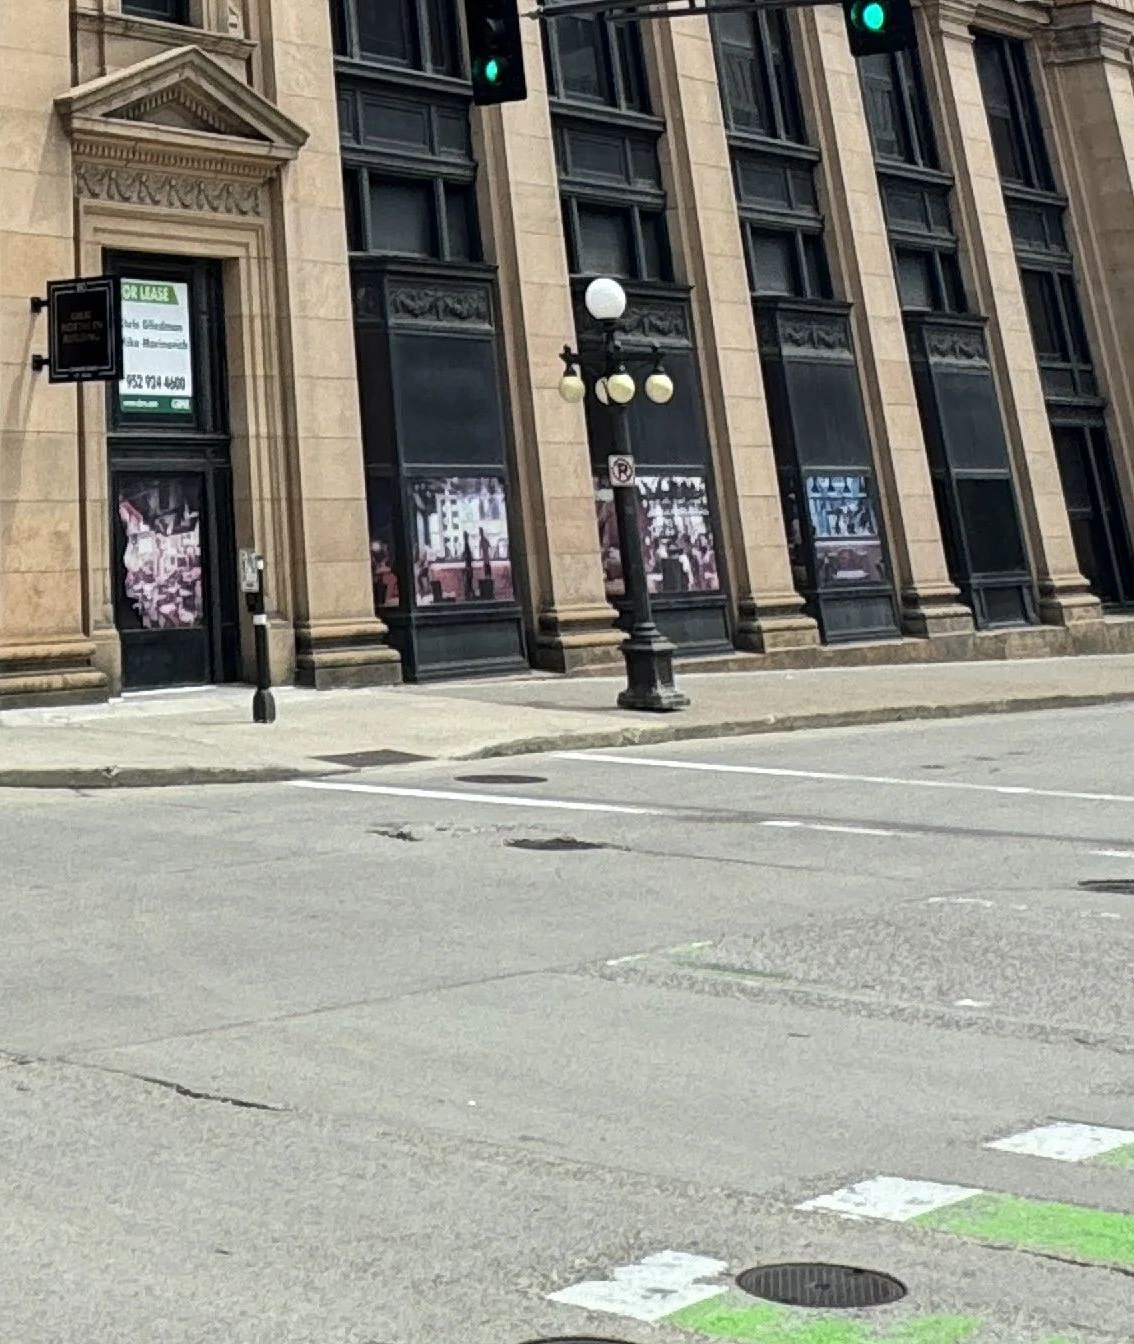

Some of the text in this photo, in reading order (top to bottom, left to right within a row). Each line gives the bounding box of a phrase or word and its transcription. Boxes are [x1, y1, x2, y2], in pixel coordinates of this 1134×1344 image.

[122, 284, 170, 303] OR LEASE
[122, 337, 140, 348] ike
[126, 374, 143, 390] 952
[164, 375, 186, 390] 4600
